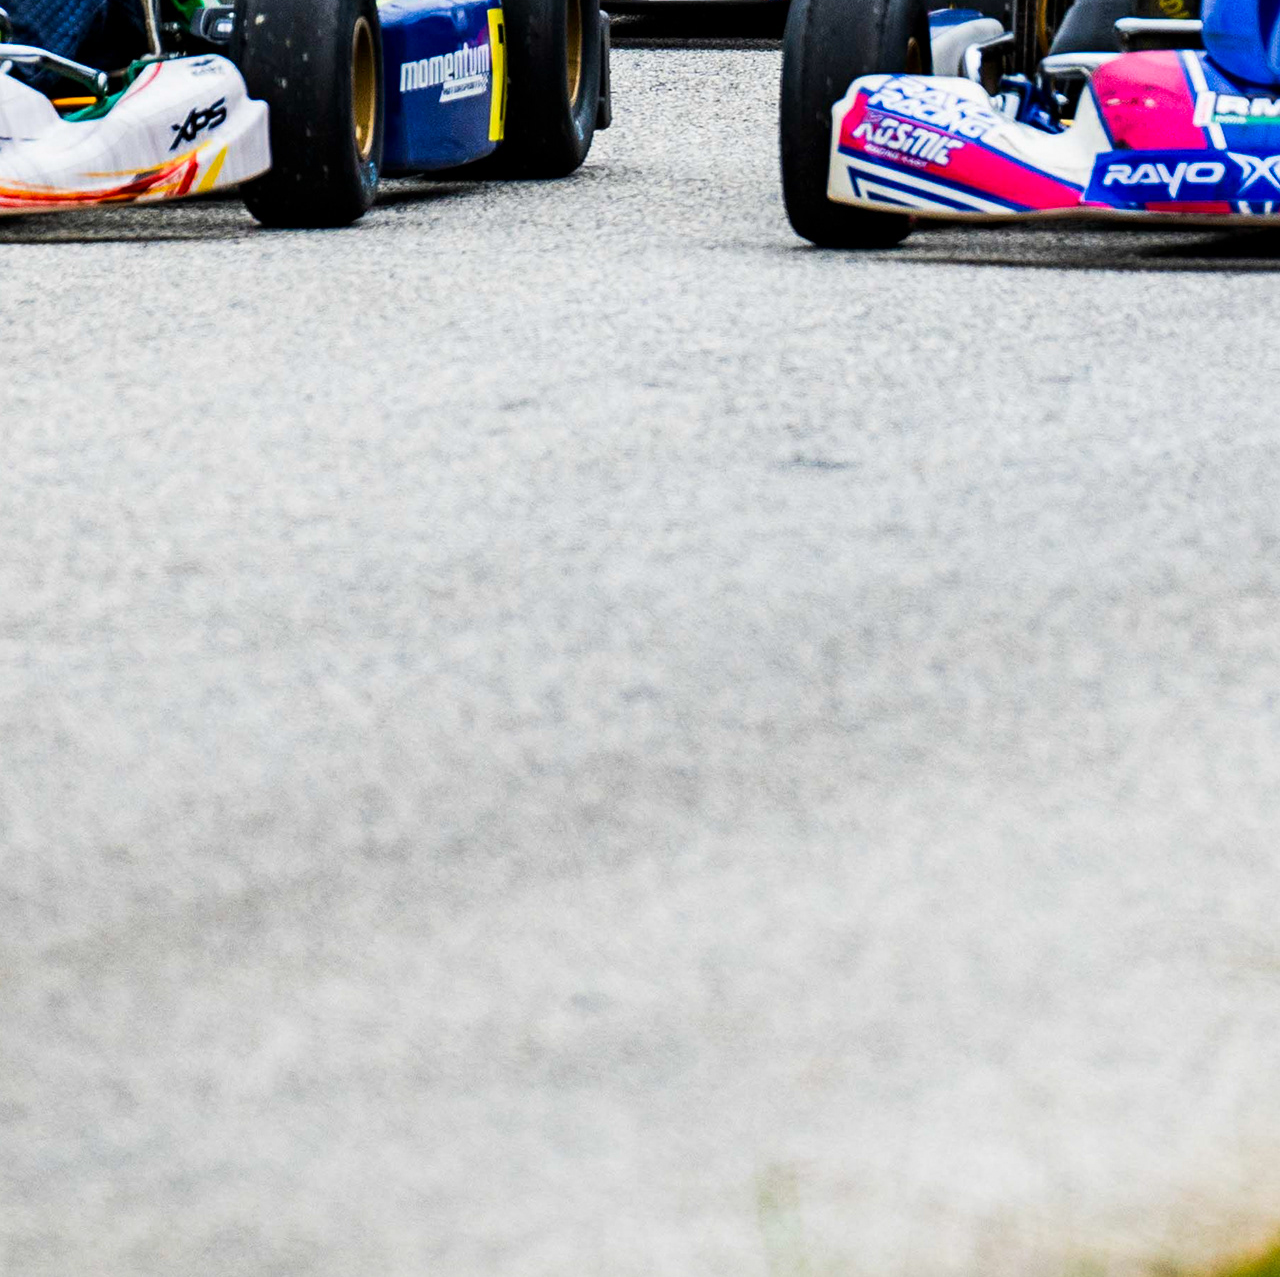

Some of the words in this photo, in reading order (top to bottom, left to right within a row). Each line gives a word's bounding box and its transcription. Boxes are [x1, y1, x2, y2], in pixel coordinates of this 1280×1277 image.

[400, 42, 490, 93] momentum
[852, 111, 966, 167] KOSMIC
[1103, 162, 1226, 198] RAYO
